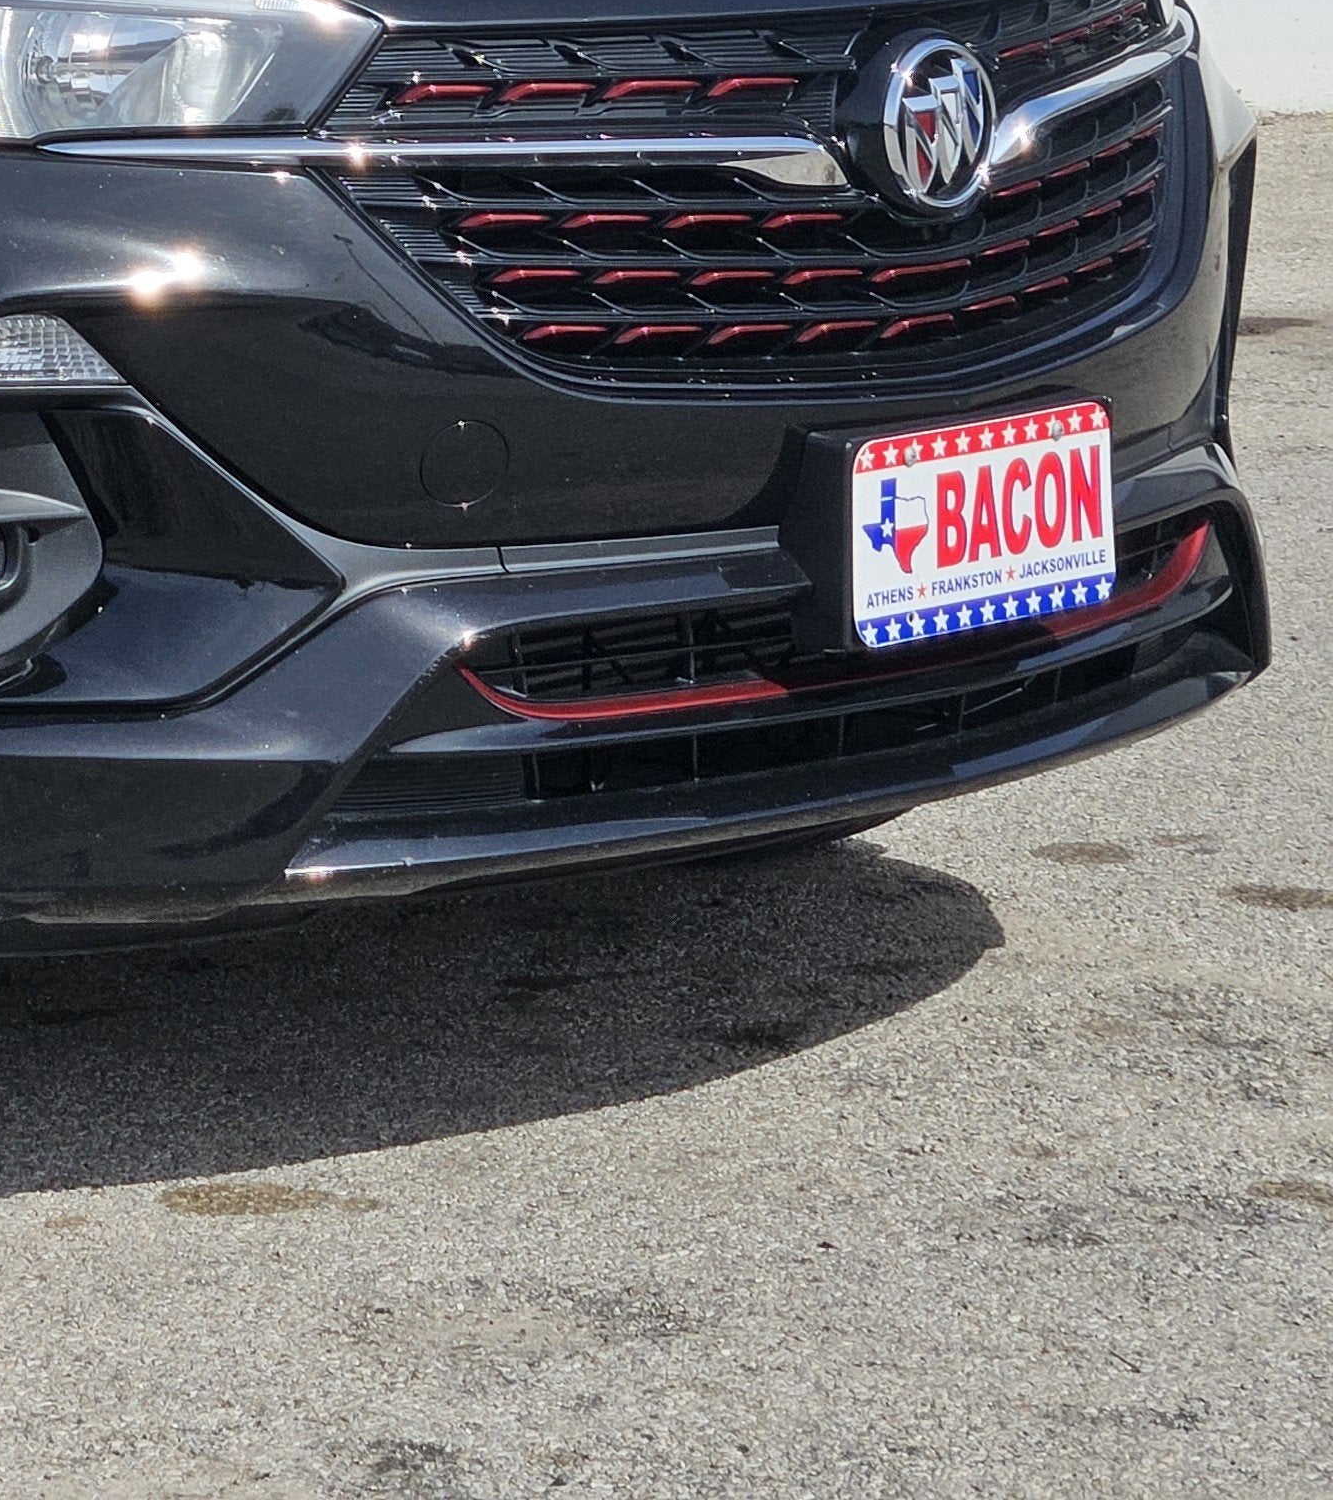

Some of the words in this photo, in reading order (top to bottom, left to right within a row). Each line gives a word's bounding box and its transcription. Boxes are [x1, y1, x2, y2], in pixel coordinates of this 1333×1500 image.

[936, 444, 1104, 569] BACON
[867, 586, 914, 609] ATHENS
[931, 569, 1002, 597] FRANKSTON
[1019, 549, 1107, 579] JACKSONVILLE
